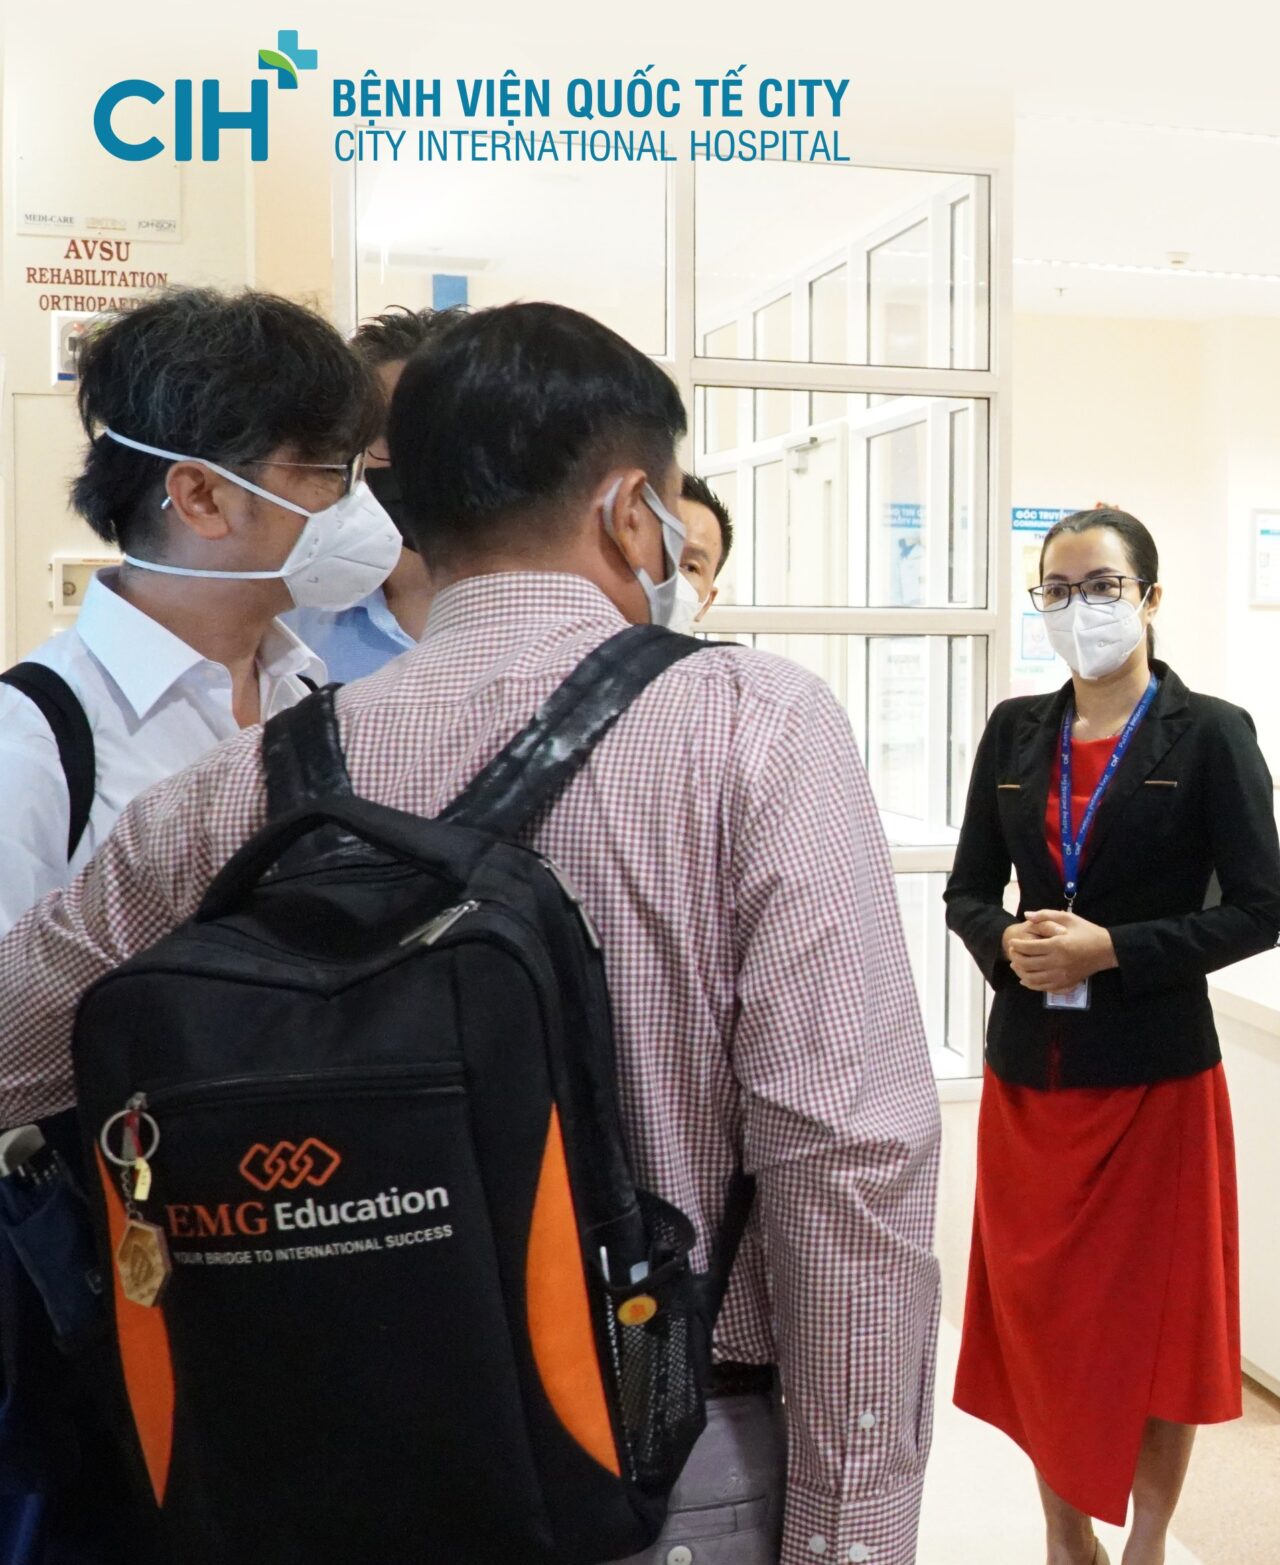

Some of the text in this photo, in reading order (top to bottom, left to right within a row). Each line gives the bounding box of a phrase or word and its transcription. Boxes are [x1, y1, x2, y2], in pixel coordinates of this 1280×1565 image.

[24, 213, 75, 225] MEDI-CARE
[64, 238, 131, 262] AVSU
[26, 267, 168, 289] REHABILITATION
[39, 294, 144, 313] ORTHOPAED
[165, 1185, 450, 1238] EMG Education
[205, 1250, 253, 1265] BRIDGE
[254, 1249, 274, 1263] TO
[275, 1238, 382, 1262] INTERNATIONAL
[385, 1224, 454, 1248] SUCCESS
